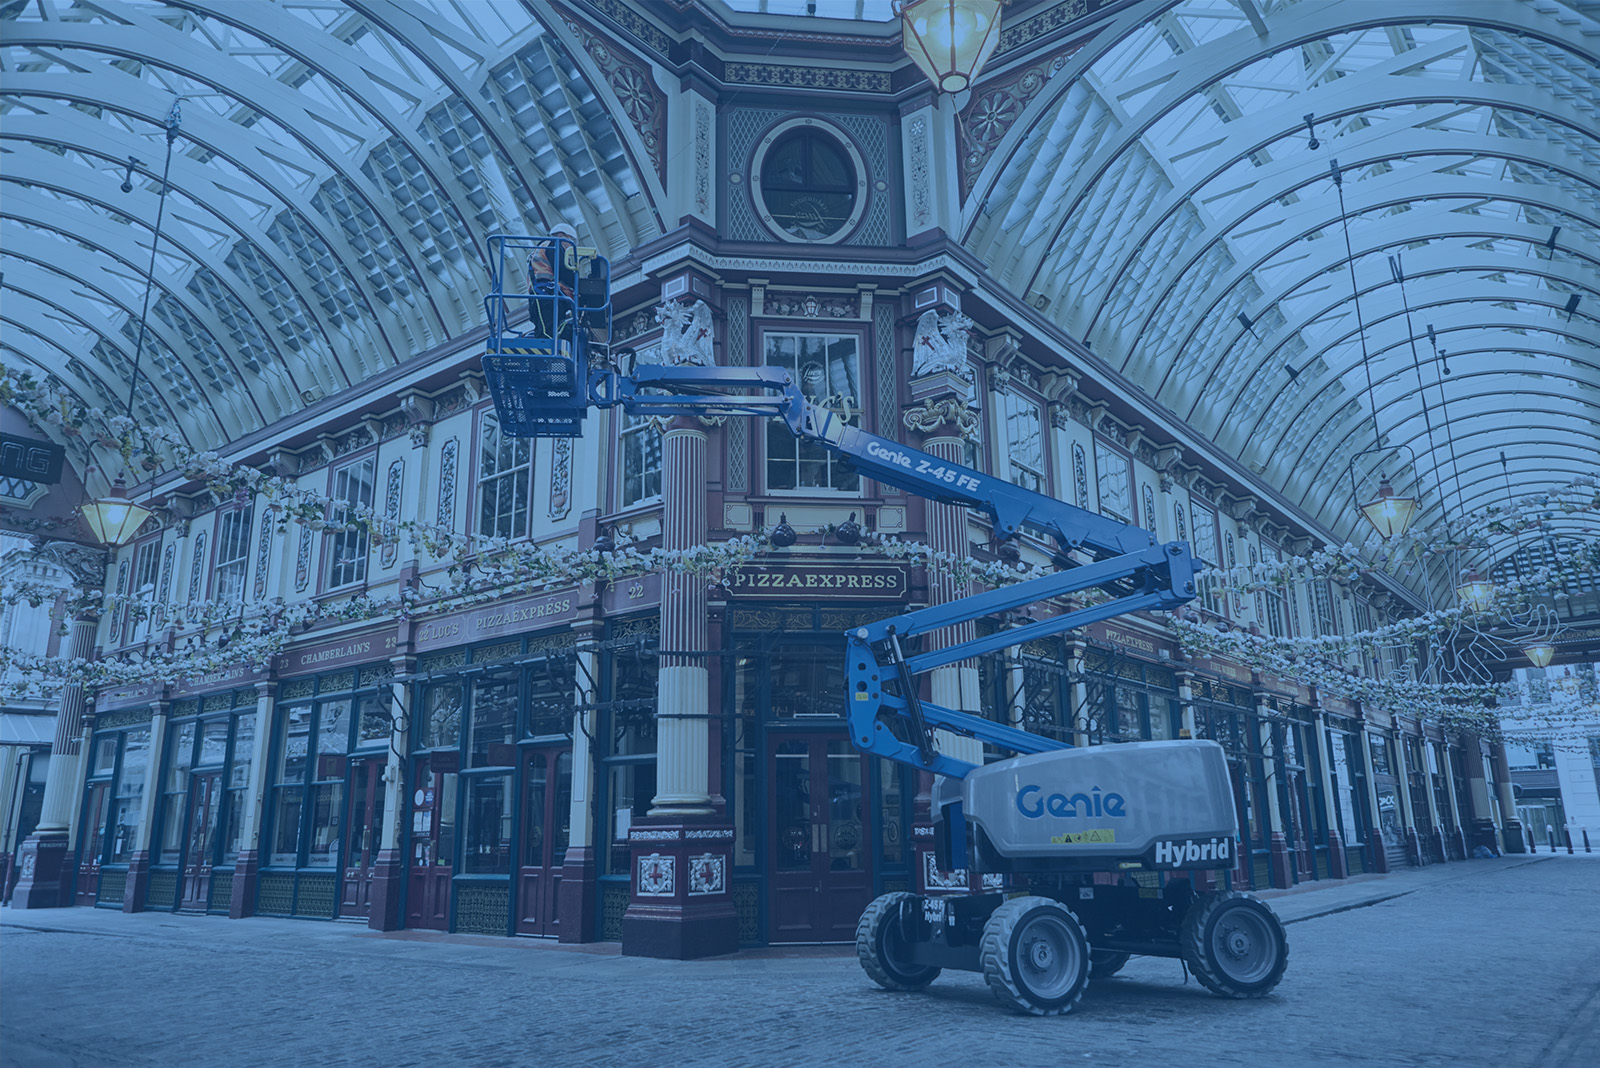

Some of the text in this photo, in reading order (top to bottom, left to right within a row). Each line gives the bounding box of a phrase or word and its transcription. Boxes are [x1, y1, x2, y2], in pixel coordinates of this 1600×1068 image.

[866, 441, 982, 492] Genie Z-45 FE
[628, 585, 644, 599] 22
[735, 573, 898, 589] PIZZAEXPRESS
[476, 599, 571, 631] PIZZAEXPRESS
[418, 622, 460, 642] 22 LUC'S
[1105, 628, 1154, 653] PIZZAEXPRESS
[300, 641, 371, 665] CHAMBERLAIN'S
[385, 636, 397, 648] 23
[1016, 784, 1128, 819] Genie
[1155, 837, 1230, 868] Hybrid
